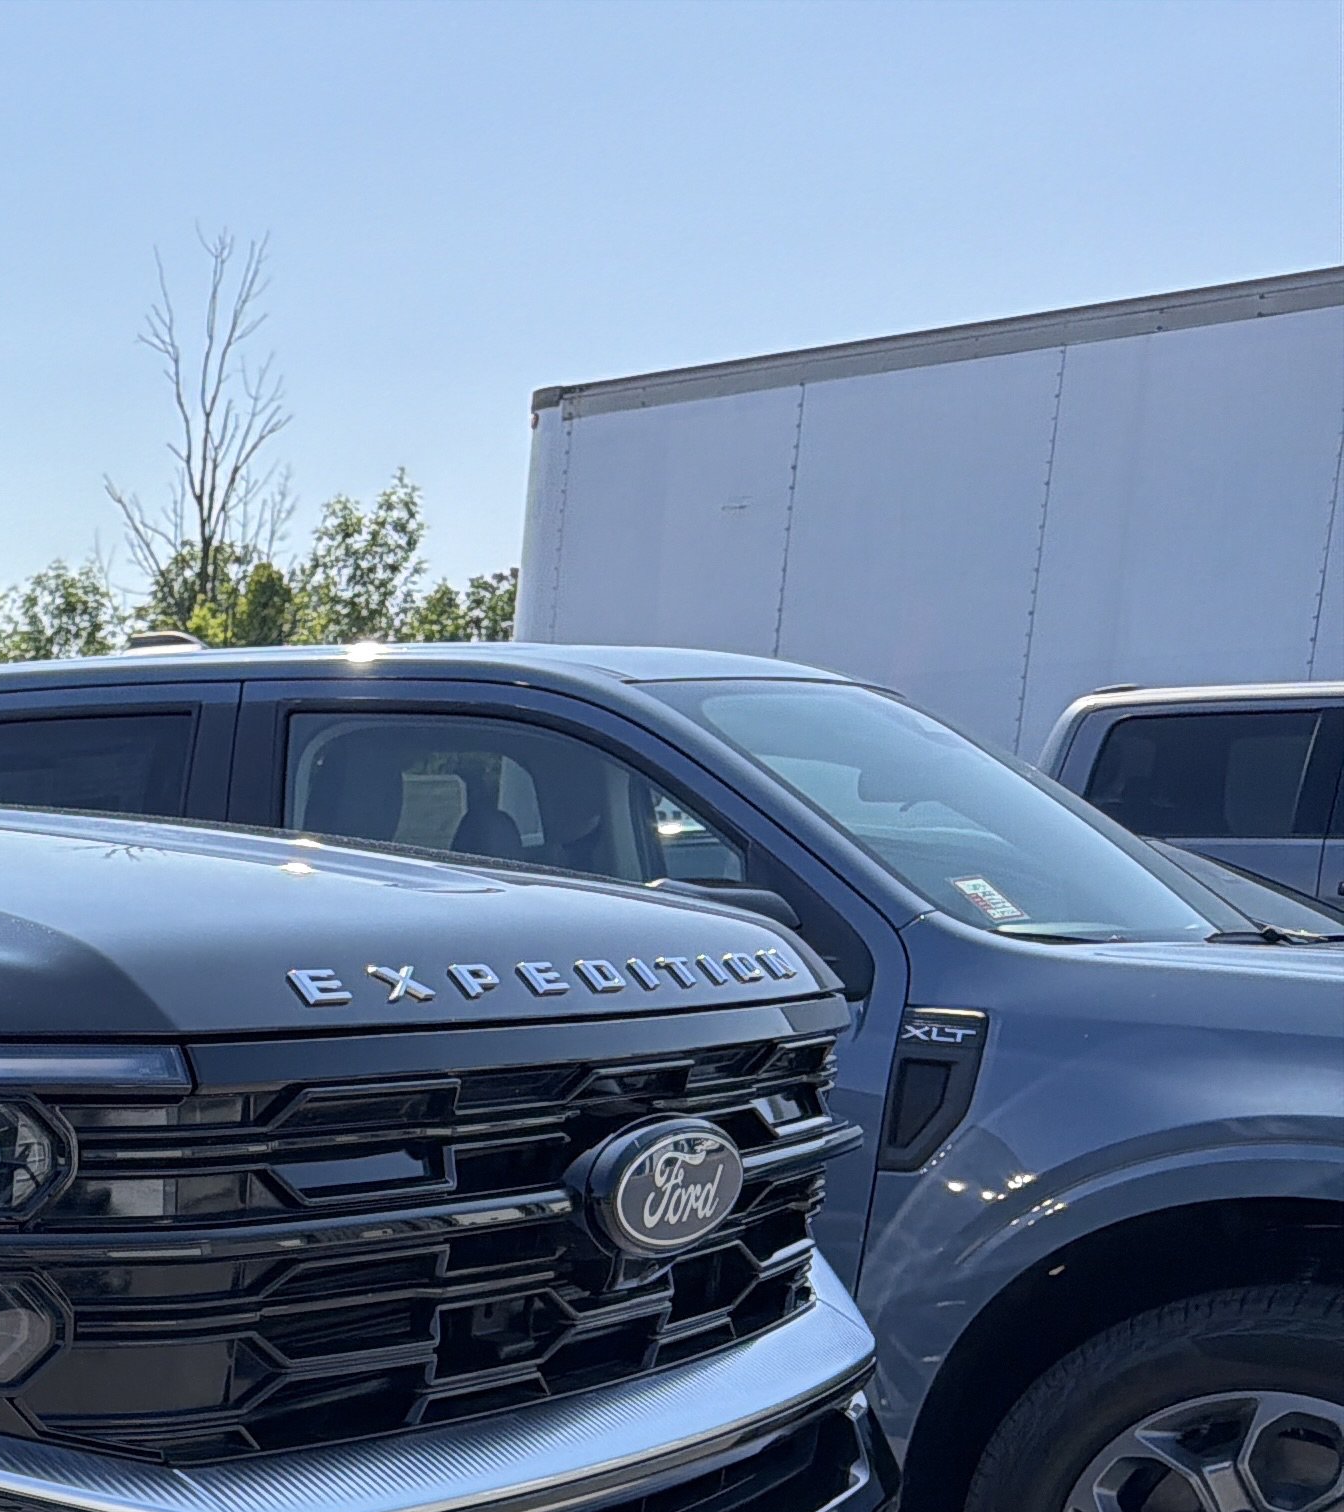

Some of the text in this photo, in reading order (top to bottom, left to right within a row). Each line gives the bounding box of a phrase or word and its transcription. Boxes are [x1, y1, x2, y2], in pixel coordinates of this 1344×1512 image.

[286, 947, 799, 1006] EXPEDITION
[901, 1025, 977, 1043] XLT
[643, 1151, 723, 1229] Ford
